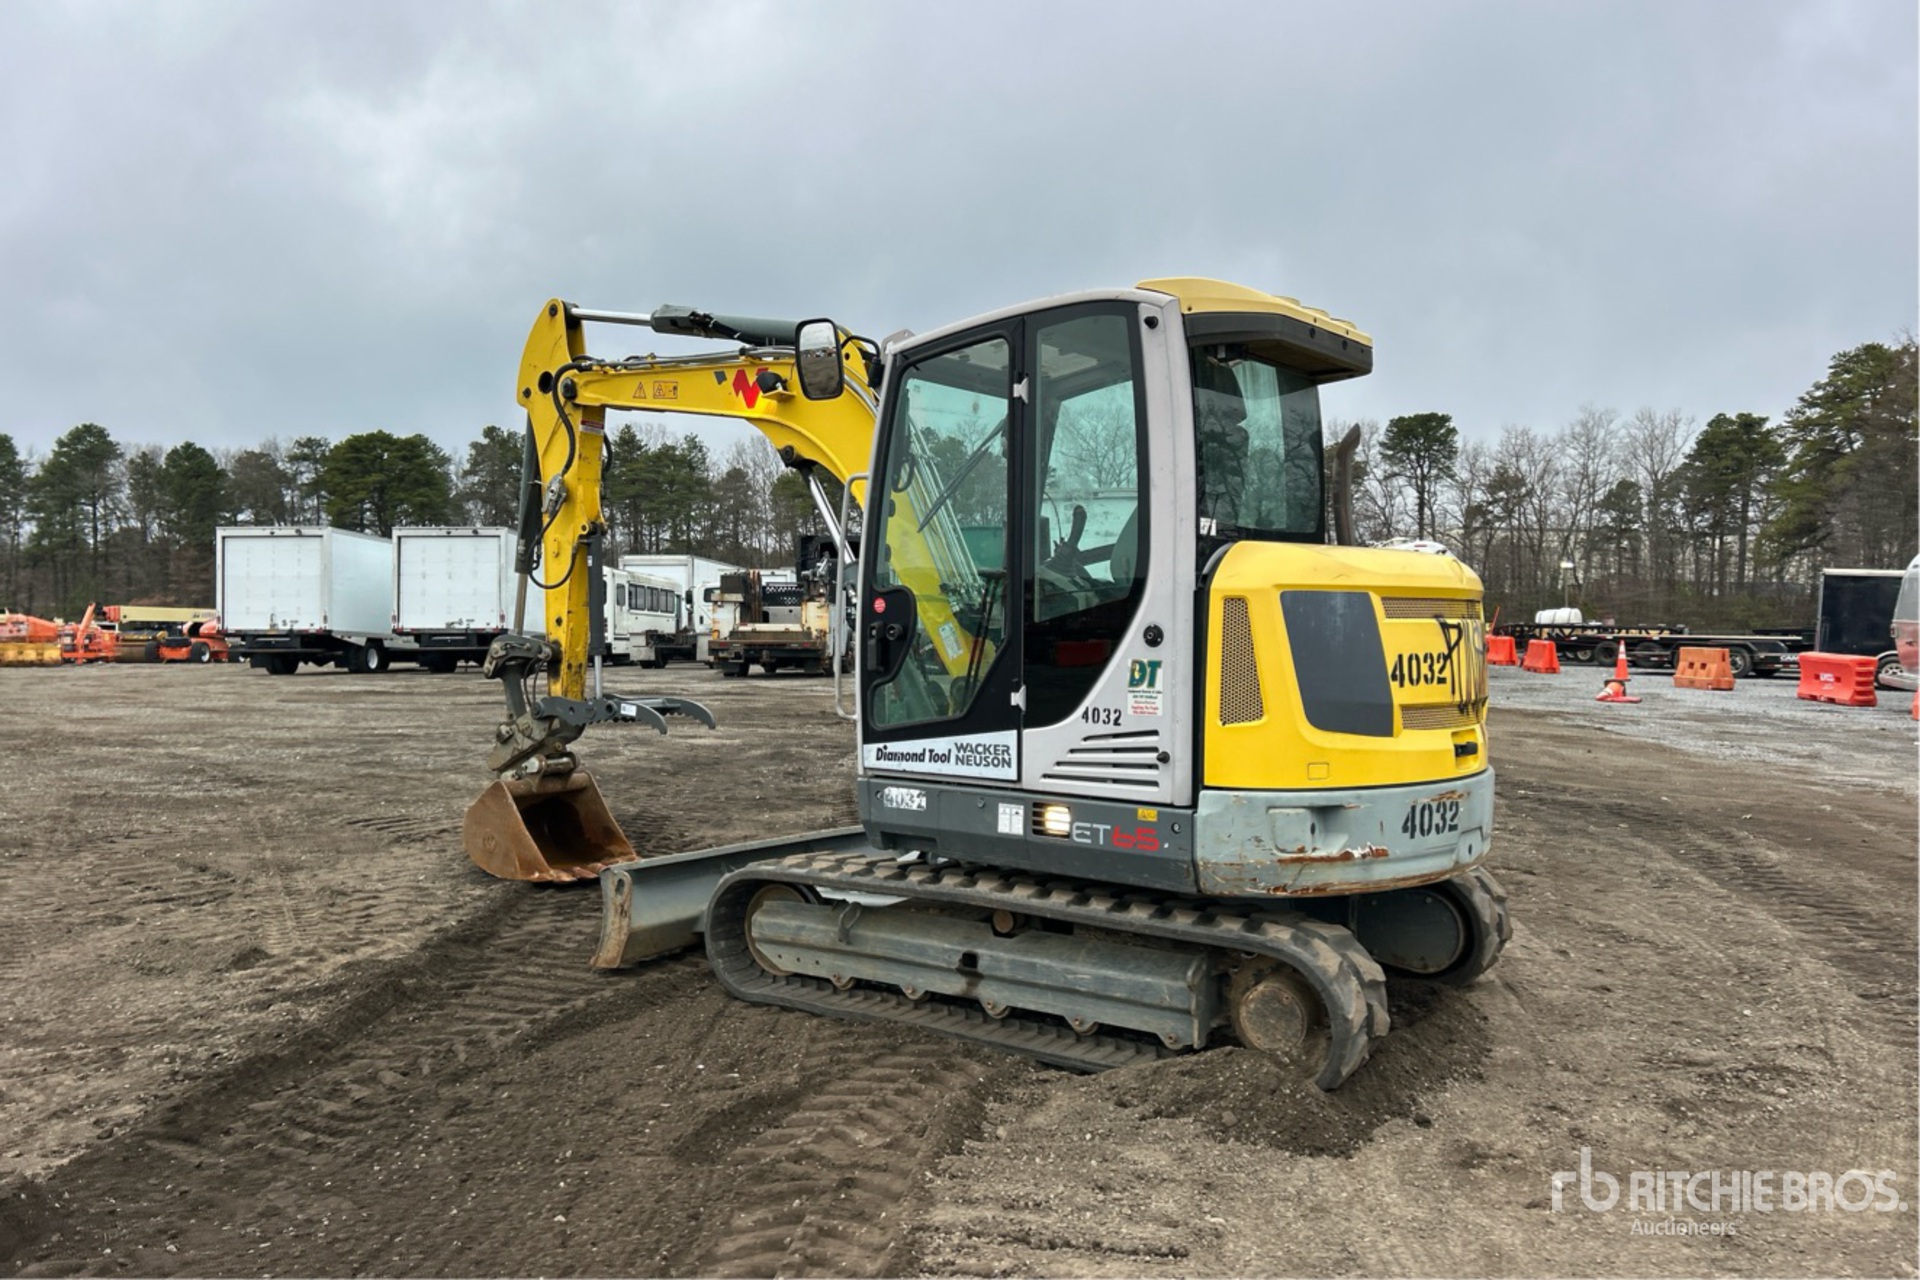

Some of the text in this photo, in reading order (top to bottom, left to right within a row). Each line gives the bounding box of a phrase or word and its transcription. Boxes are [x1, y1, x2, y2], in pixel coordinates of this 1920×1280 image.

[1127, 659, 1163, 689] DT
[1391, 652, 1447, 688] 4032
[1081, 706, 1122, 726] 4032
[875, 745, 951, 764] Diamond Tool
[954, 742, 1011, 757] WACKER
[954, 754, 1012, 769] NEUSON
[1402, 801, 1459, 839] 4032
